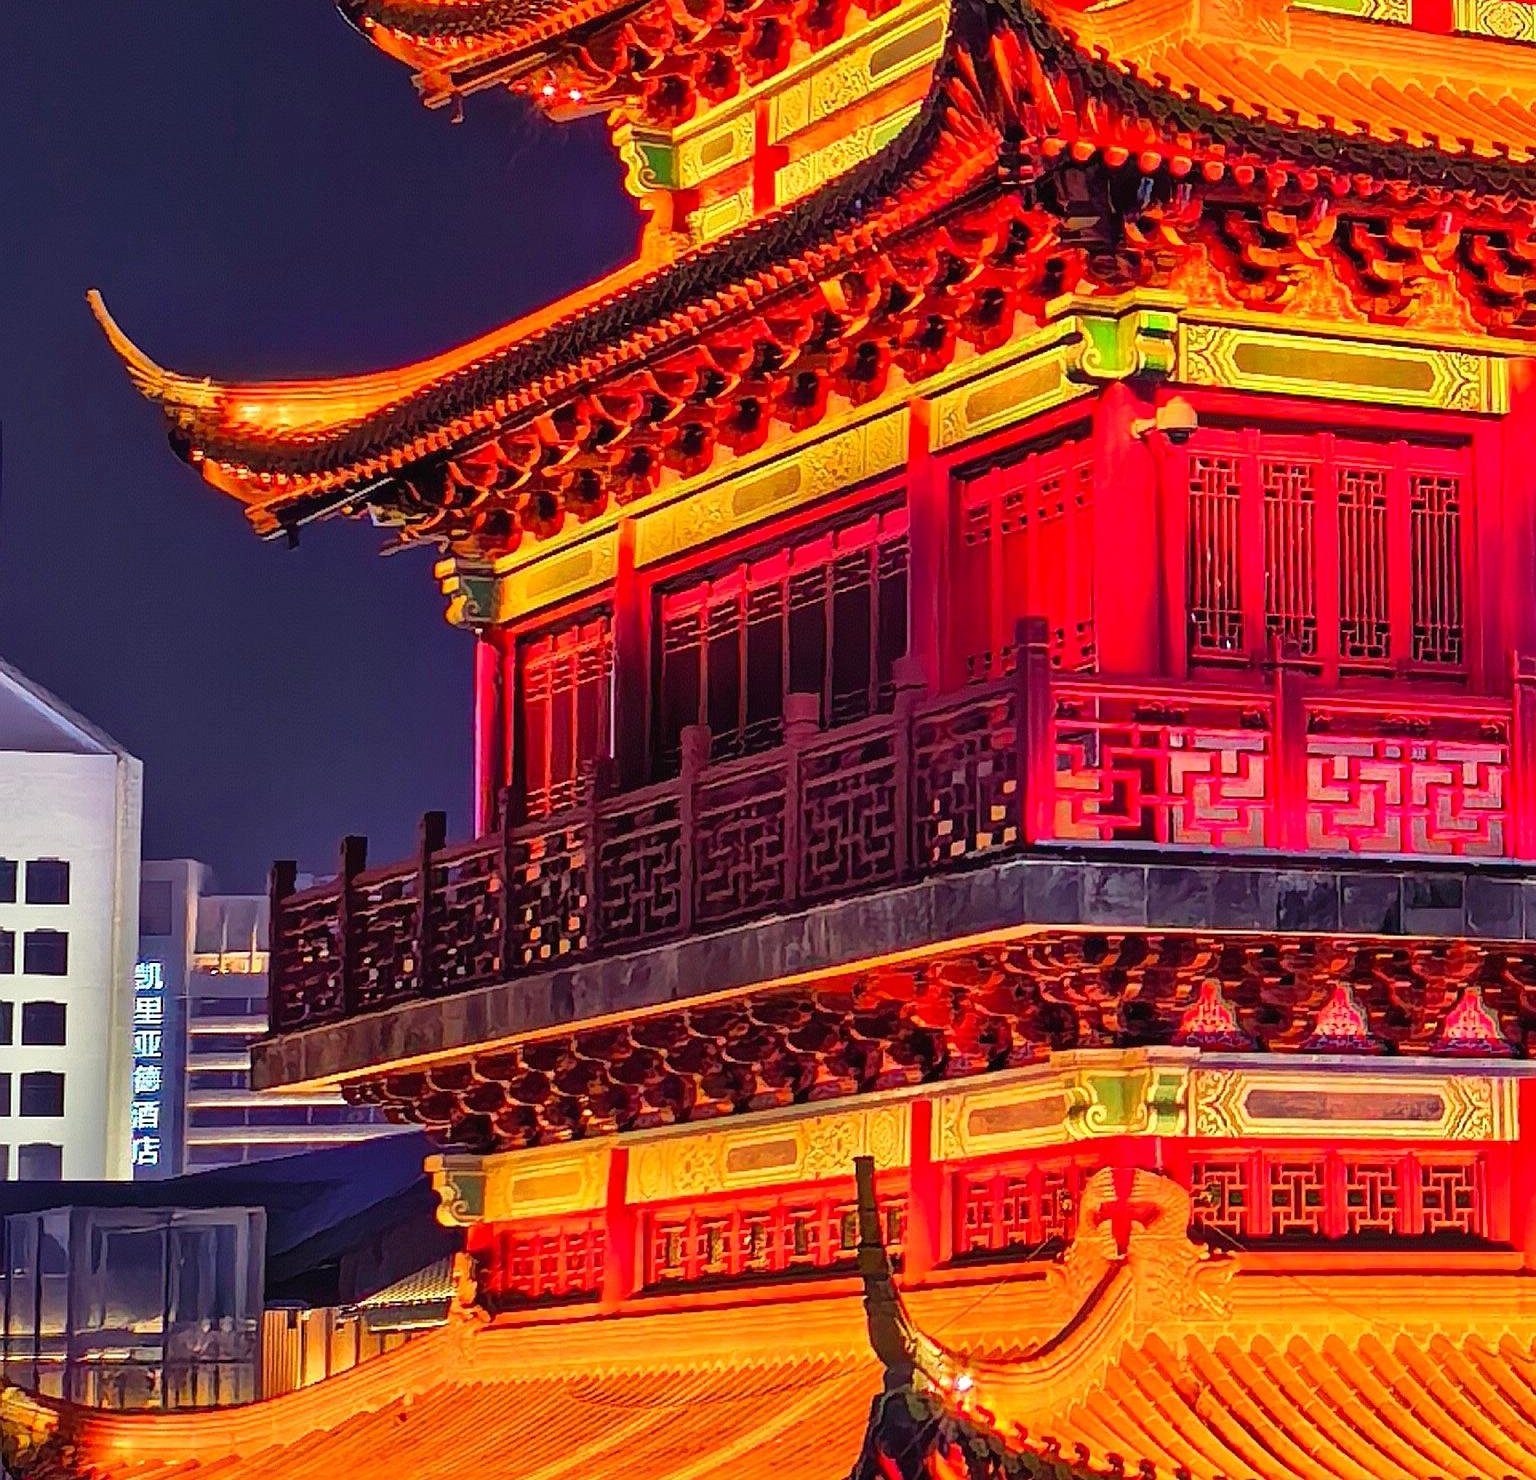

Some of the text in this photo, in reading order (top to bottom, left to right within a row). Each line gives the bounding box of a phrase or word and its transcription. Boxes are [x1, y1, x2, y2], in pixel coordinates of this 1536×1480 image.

[131, 962, 164, 1166] 凯里亚德酒店
